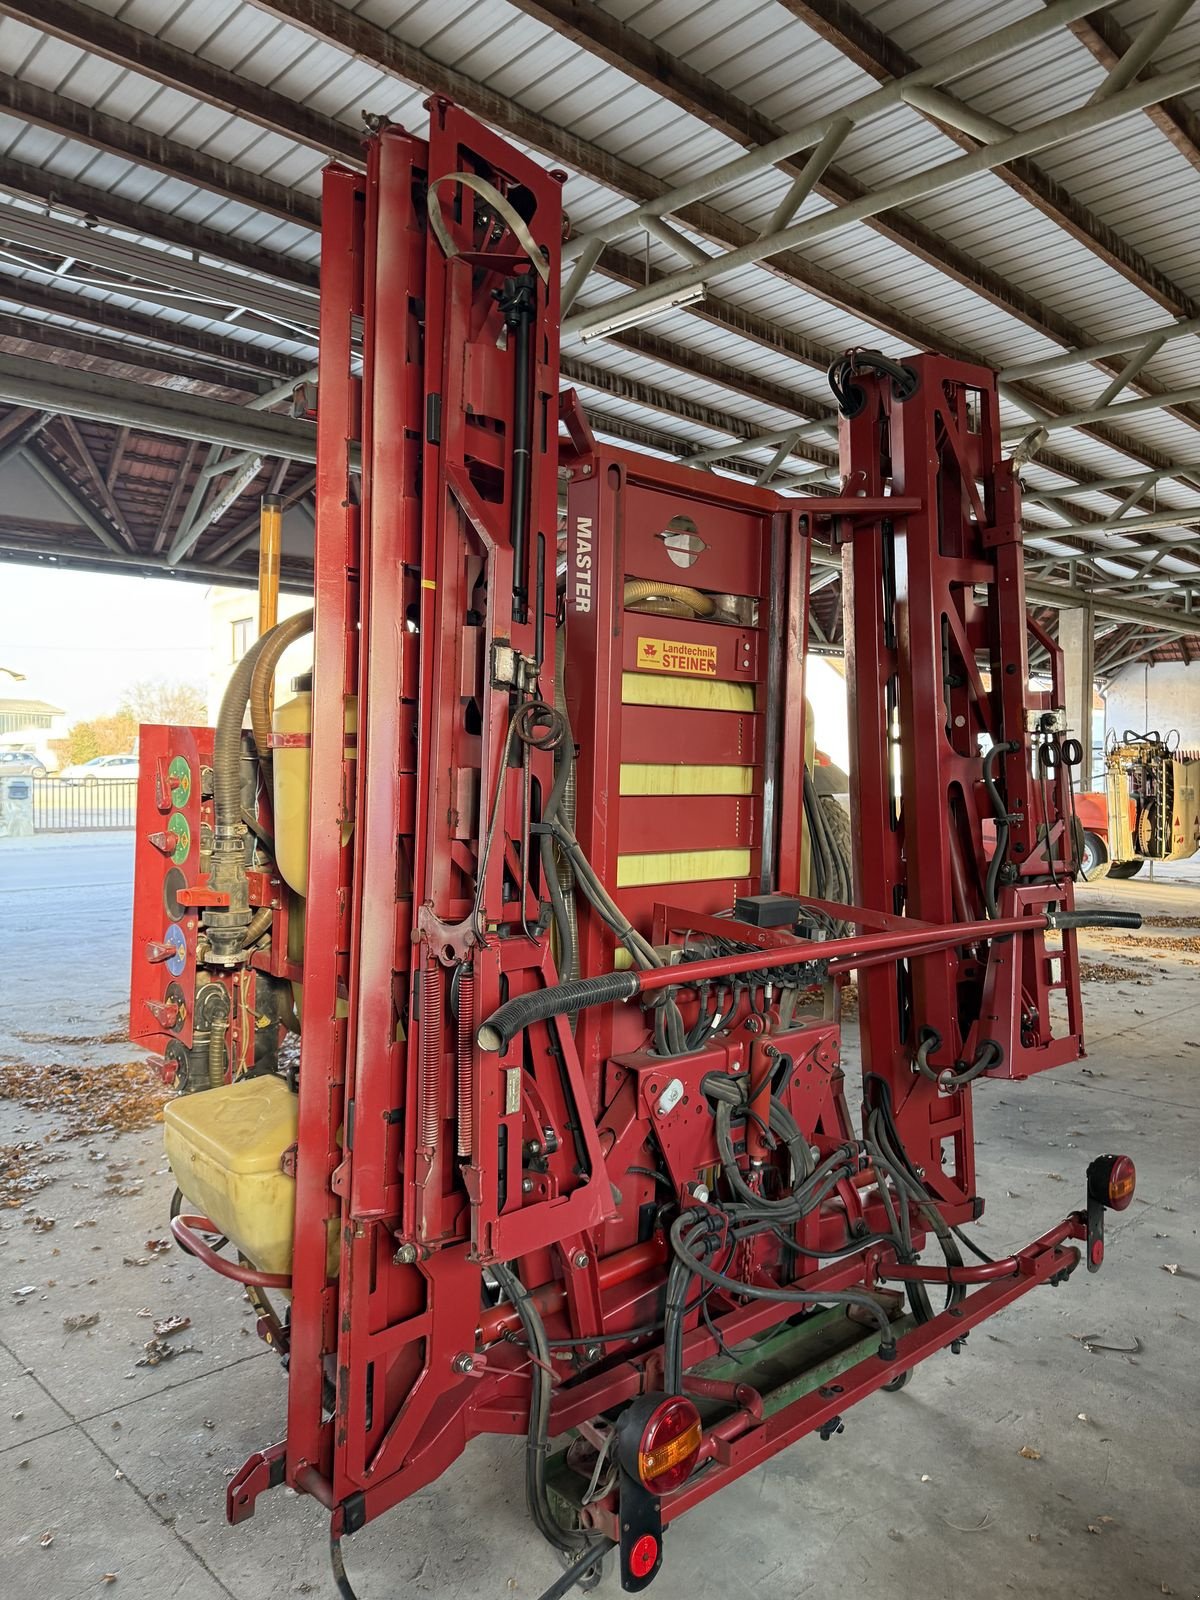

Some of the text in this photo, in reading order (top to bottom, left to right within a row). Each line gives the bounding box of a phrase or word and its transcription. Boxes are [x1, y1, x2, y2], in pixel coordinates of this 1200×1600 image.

[575, 516, 593, 613] MASTER
[663, 643, 715, 658] Landtechnik
[662, 654, 715, 672] STEINER
